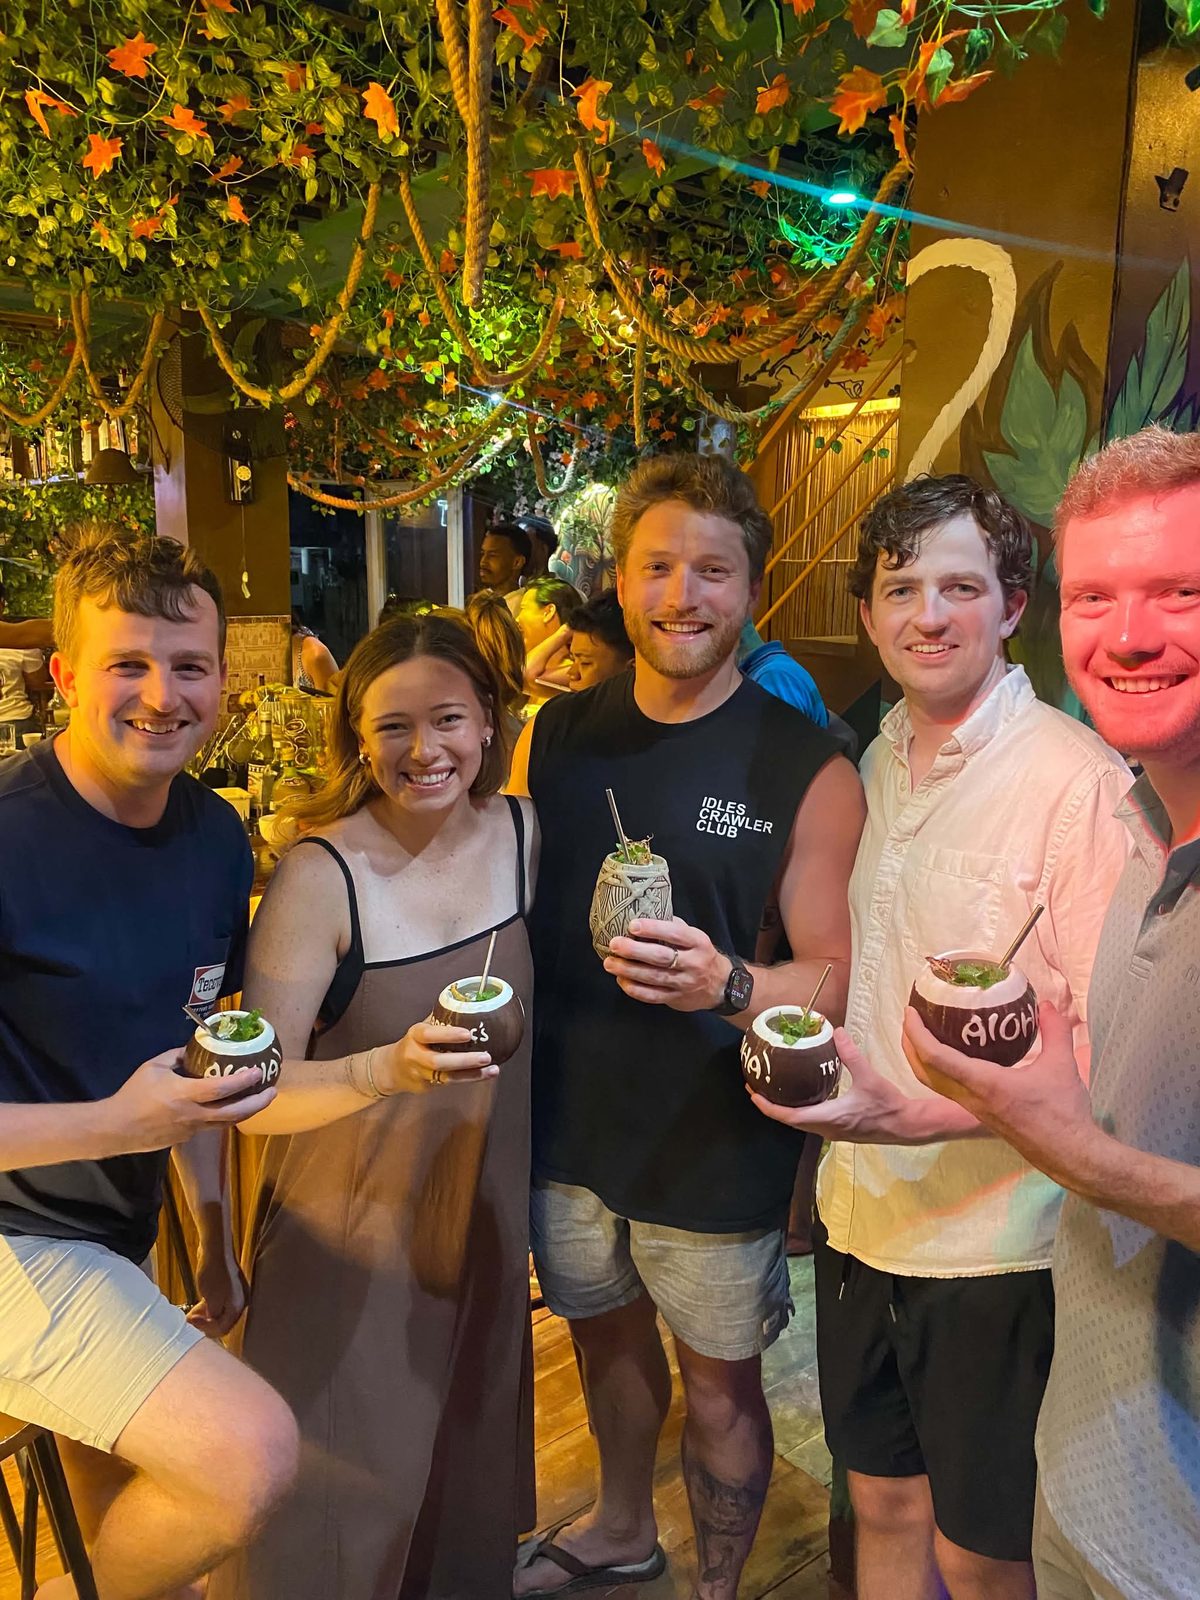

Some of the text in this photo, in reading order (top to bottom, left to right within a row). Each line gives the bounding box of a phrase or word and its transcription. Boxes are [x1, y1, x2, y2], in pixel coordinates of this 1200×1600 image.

[701, 796, 747, 816] IDLES
[695, 819, 738, 839] CLUB
[699, 807, 774, 834] CRAWLER
